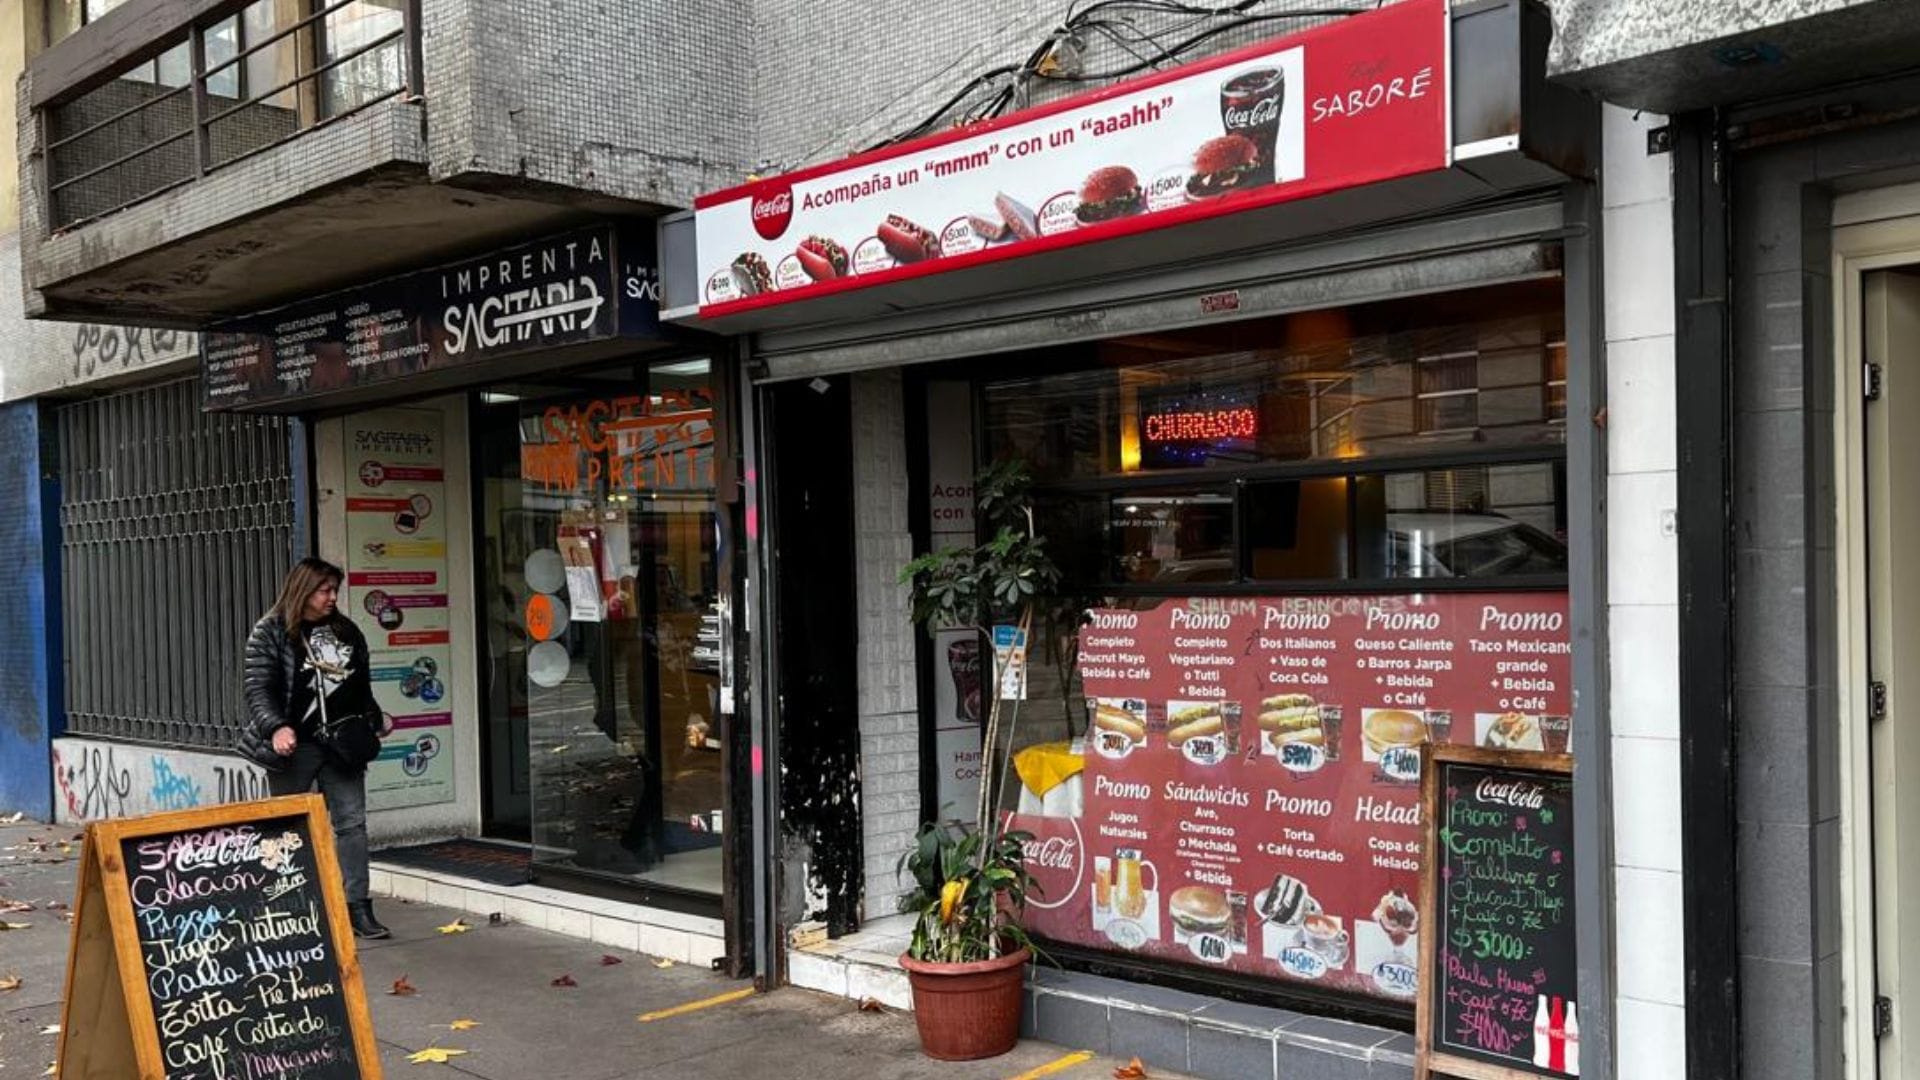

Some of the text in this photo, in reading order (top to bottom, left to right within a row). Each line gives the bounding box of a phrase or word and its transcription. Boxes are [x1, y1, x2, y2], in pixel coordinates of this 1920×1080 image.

[1312, 68, 1432, 123] SABORÉ
[803, 174, 893, 211] Acompaña
[898, 170, 919, 186] un
[1006, 136, 1042, 160] con
[1050, 131, 1075, 149] un
[442, 236, 603, 299] IMPRENTA
[1146, 408, 1255, 440] CHURRASCO
[1170, 607, 1231, 629] Promo
[1263, 607, 1331, 630] Promo
[1366, 606, 1440, 631] Promo
[1480, 604, 1562, 632] Promo
[1087, 636, 1135, 648] Completo
[1174, 636, 1228, 648] Completo
[1260, 636, 1336, 650] Dos Italianos
[1354, 637, 1454, 652] Queso Caliente
[1469, 639, 1502, 652] Taco
[1077, 651, 1146, 664] Chucrut Mayo
[1169, 653, 1235, 667] Vegetariano
[1279, 654, 1308, 667] Vaso
[1311, 655, 1327, 667] de
[1356, 657, 1452, 672] o Barros Jarpa
[1082, 667, 1116, 678] Bebida
[1127, 667, 1151, 679] Café
[1496, 659, 1548, 673] grande
[1184, 669, 1220, 682] o Tutti
[1269, 671, 1329, 685] Coca Cola
[1387, 675, 1434, 688] Bebida
[1188, 685, 1227, 697] Bebida
[1503, 677, 1555, 691] Bebida
[1384, 692, 1426, 706] o Café
[1499, 697, 1546, 710] o Café
[1095, 775, 1150, 799] Promo
[1164, 780, 1249, 806] Sándwichs
[1265, 789, 1331, 815] Promo
[1109, 811, 1138, 824] Jugos
[1100, 825, 1147, 839] Naturales
[1180, 821, 1235, 836] Churrasco
[1283, 828, 1315, 842] Torta
[1188, 837, 1237, 853] Mechada
[1368, 836, 1402, 853] Copa
[1267, 843, 1293, 856] Café
[1296, 849, 1344, 862] cortado
[1373, 854, 1419, 871] Helado
[1194, 870, 1232, 886] Bebida
